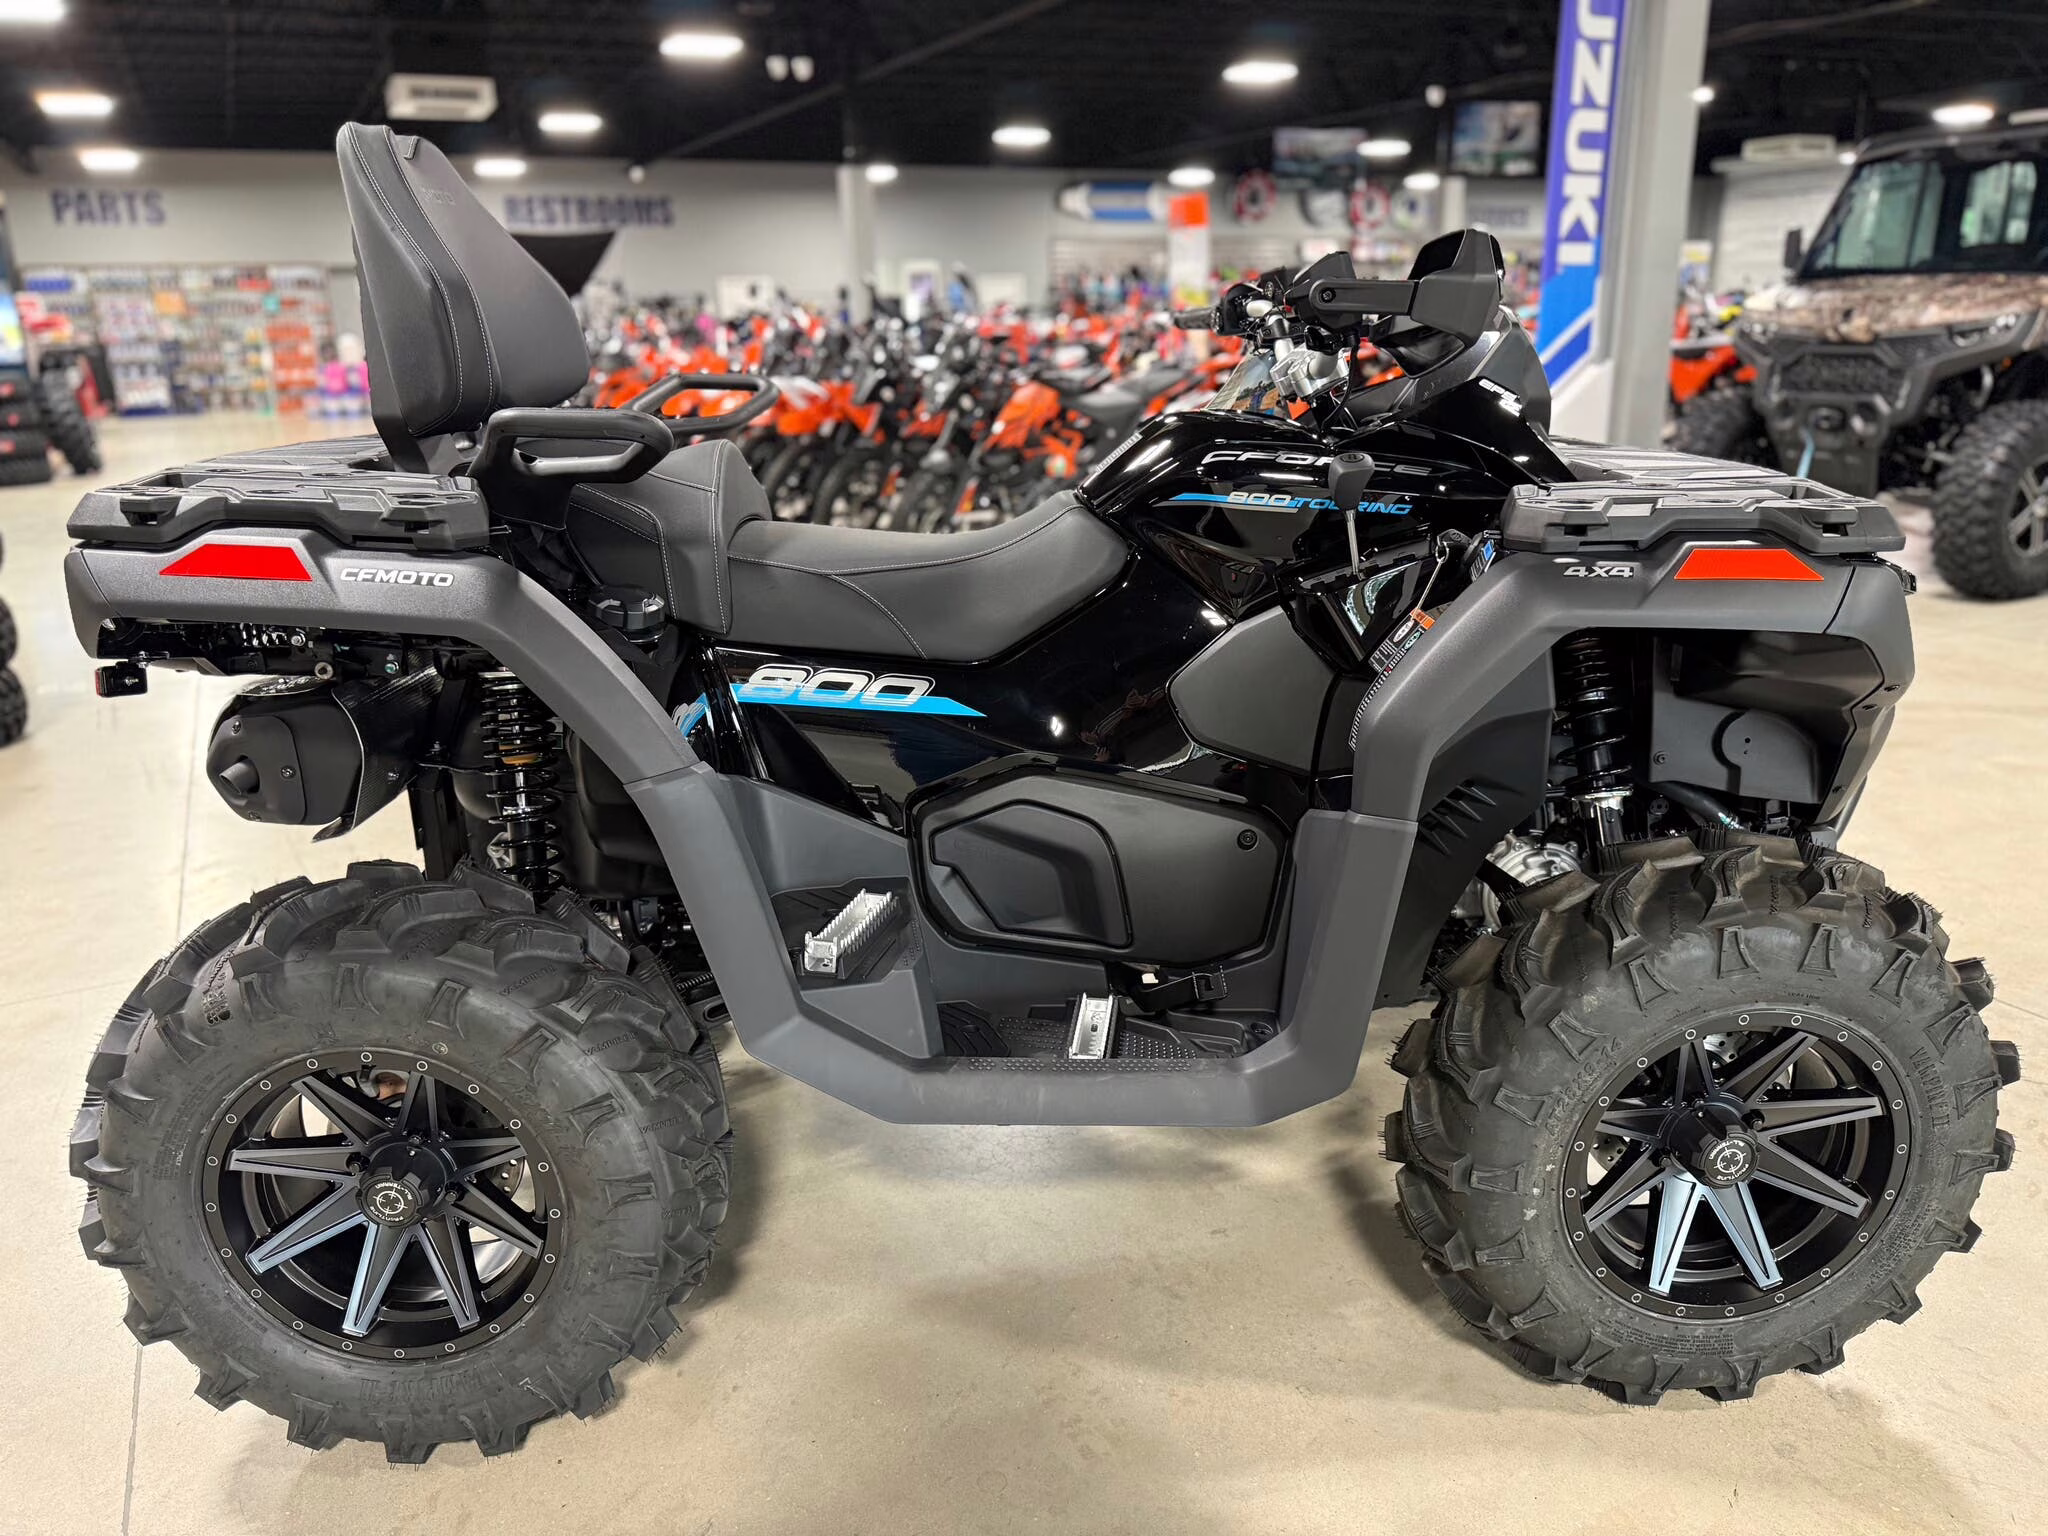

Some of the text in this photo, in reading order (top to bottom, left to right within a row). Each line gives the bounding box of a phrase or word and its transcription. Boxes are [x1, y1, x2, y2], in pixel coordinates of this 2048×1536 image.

[51, 188, 167, 226] PARTS
[505, 195, 675, 228] RESTROOMS
[1227, 490, 1293, 507] 800
[340, 566, 455, 588] CFMOTO
[736, 663, 936, 707] 800
